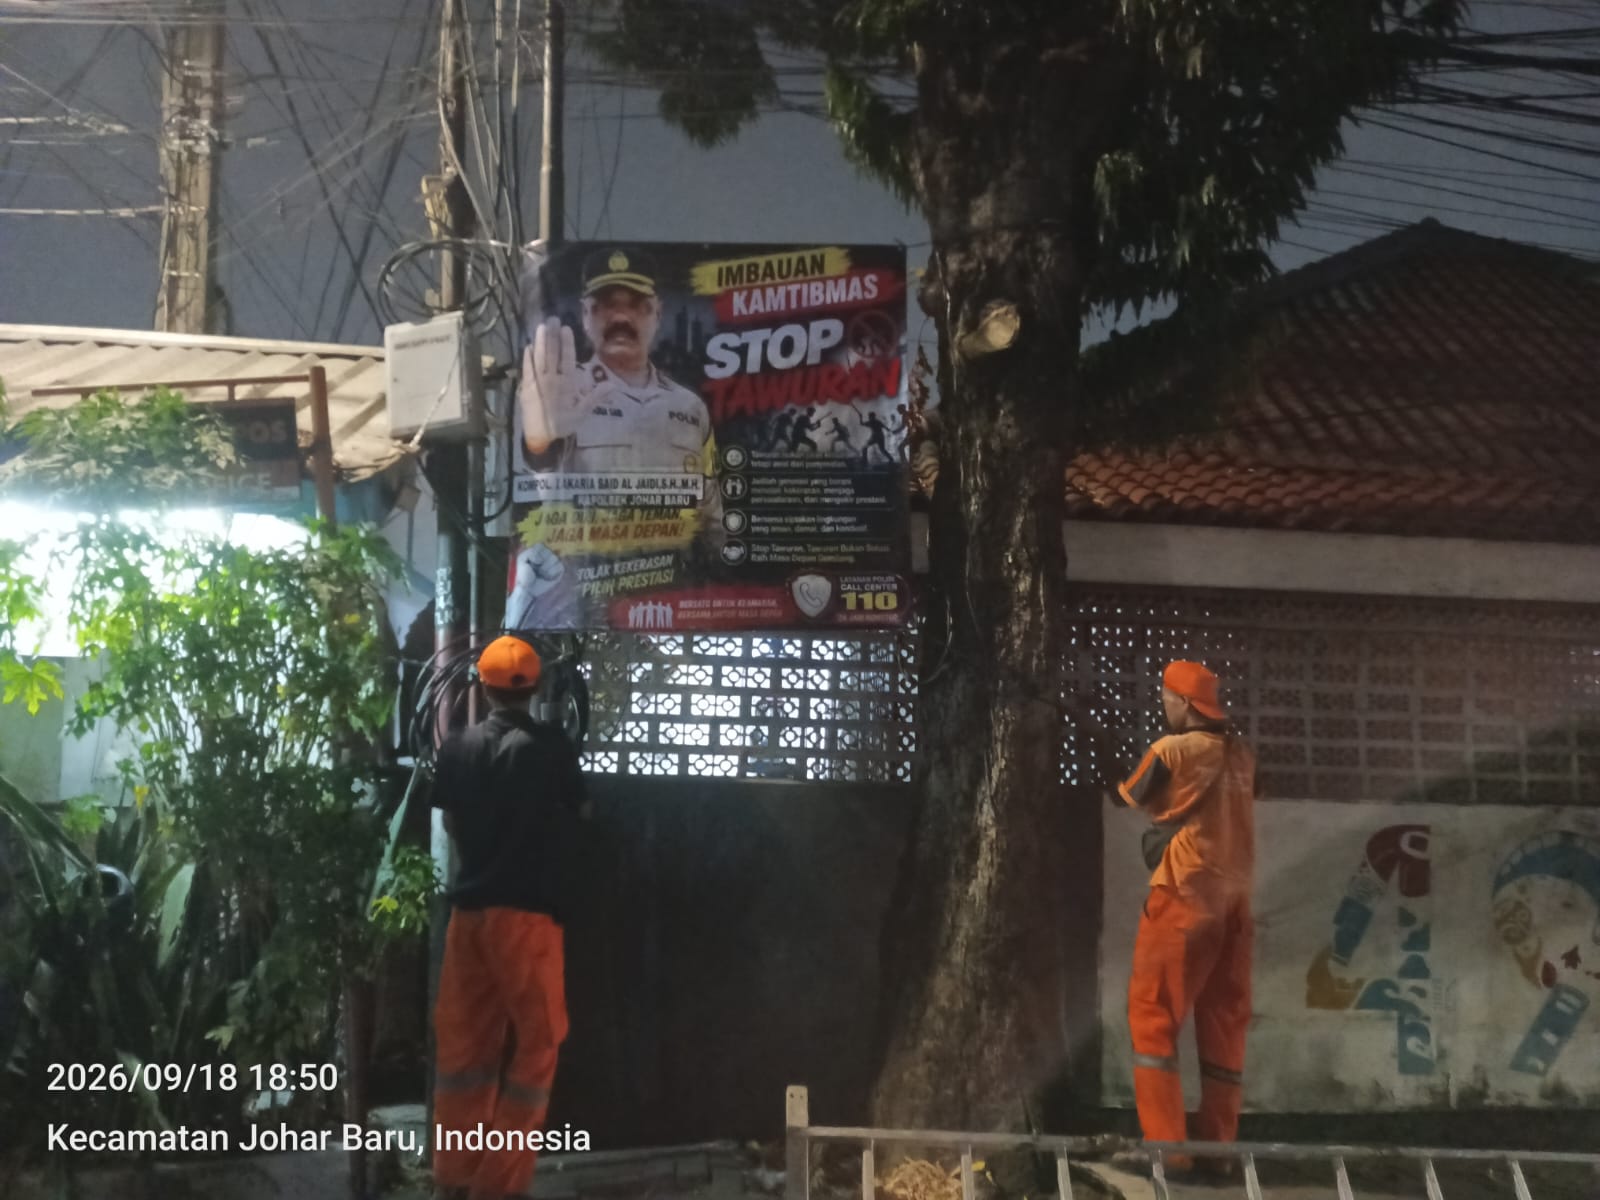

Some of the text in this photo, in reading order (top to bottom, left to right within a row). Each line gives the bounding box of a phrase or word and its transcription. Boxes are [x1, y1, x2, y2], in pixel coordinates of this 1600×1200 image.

[718, 253, 825, 287] IMBAUAN
[733, 274, 878, 317] KAMTIBMAS
[704, 318, 844, 379] STOP
[702, 357, 900, 418] TAWURAN
[598, 478, 619, 490] SAID
[622, 478, 633, 489] AL
[630, 495, 662, 505] JOHAR
[664, 494, 690, 505] BARU
[588, 525, 629, 540] MASA
[633, 522, 686, 539] DEPAN!
[576, 554, 674, 581] TOLAK KEKERASAN
[581, 569, 675, 598] PILIH PRESTASI
[840, 583, 898, 591] CALL CENTER
[840, 592, 898, 610] 110
